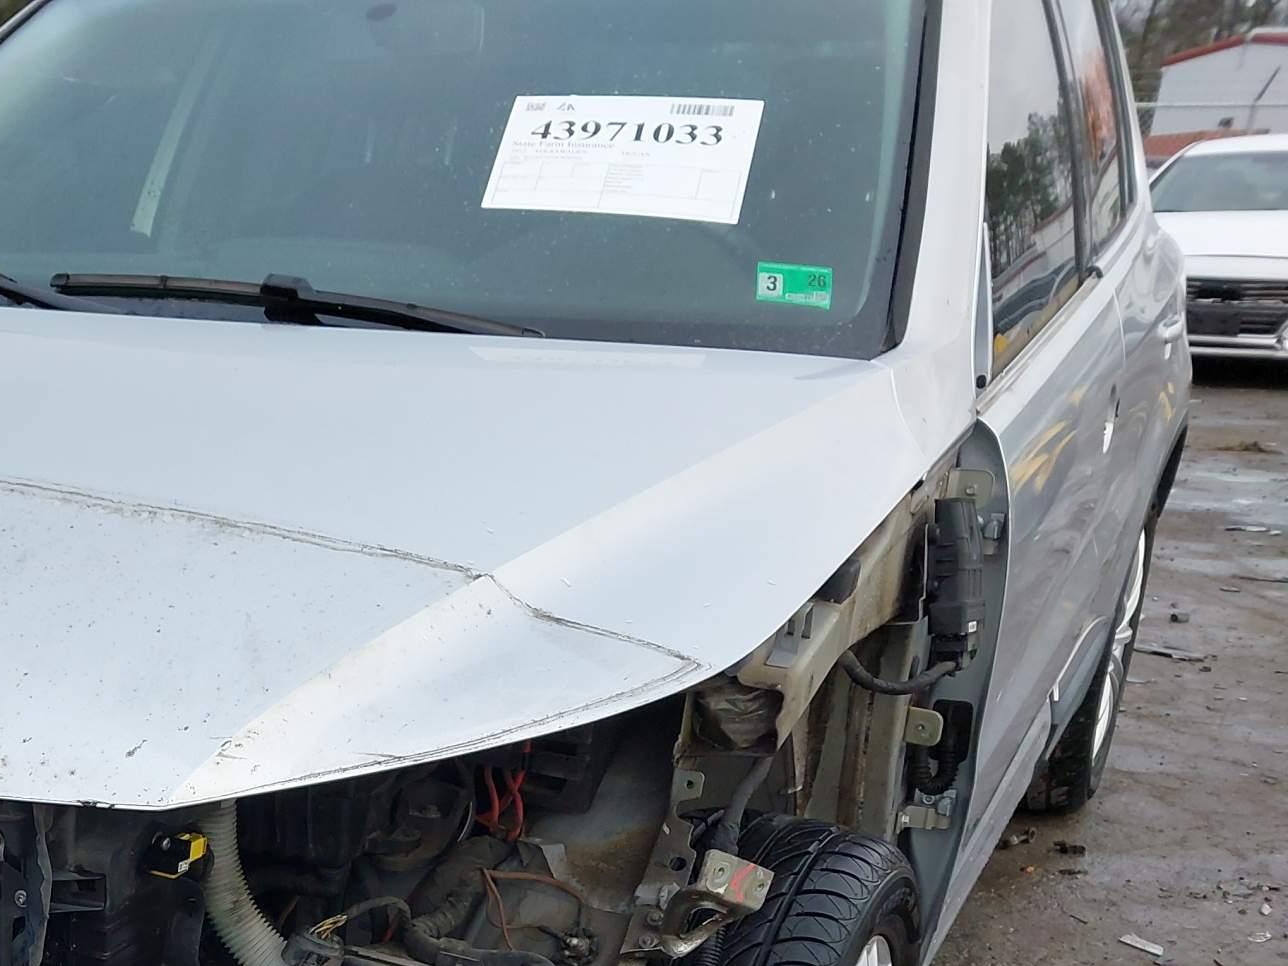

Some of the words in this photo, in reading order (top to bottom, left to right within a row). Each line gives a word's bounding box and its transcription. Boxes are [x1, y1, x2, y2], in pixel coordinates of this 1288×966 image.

[530, 119, 724, 147] 43971033
[766, 275, 778, 291] 3
[808, 274, 827, 288] 26
